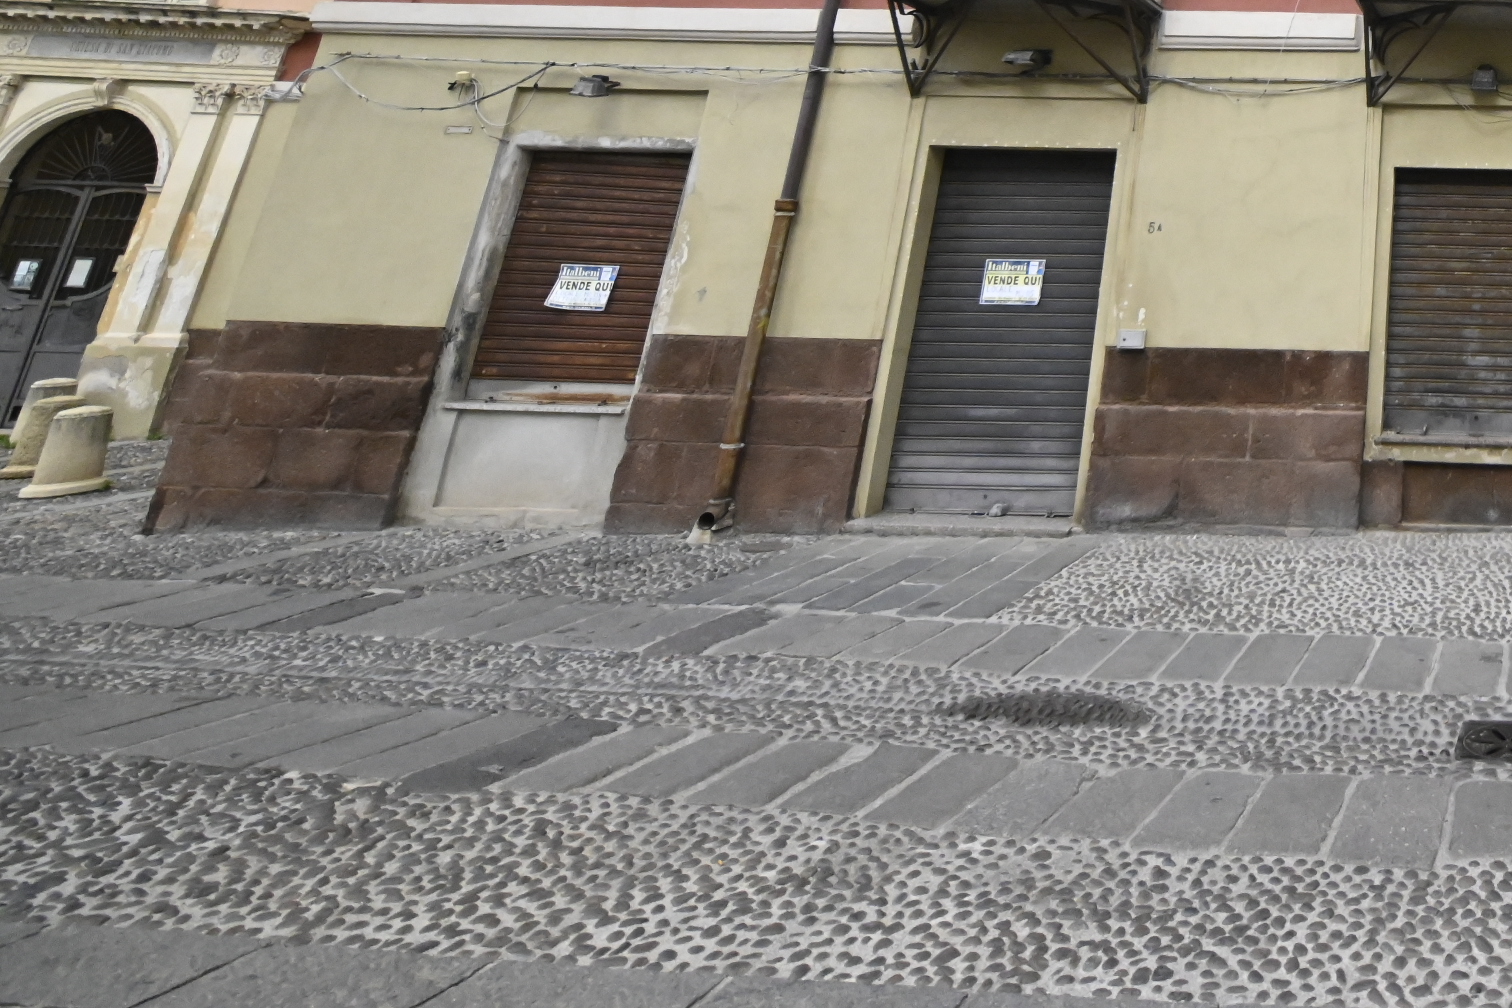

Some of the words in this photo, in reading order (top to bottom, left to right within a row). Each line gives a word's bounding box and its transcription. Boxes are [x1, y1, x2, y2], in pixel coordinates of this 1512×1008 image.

[562, 266, 601, 277] Italbeni
[987, 261, 1028, 271] Italbeni
[559, 280, 592, 291] VENDE
[987, 275, 1020, 286] VENDE
[1023, 276, 1041, 286] QUI
